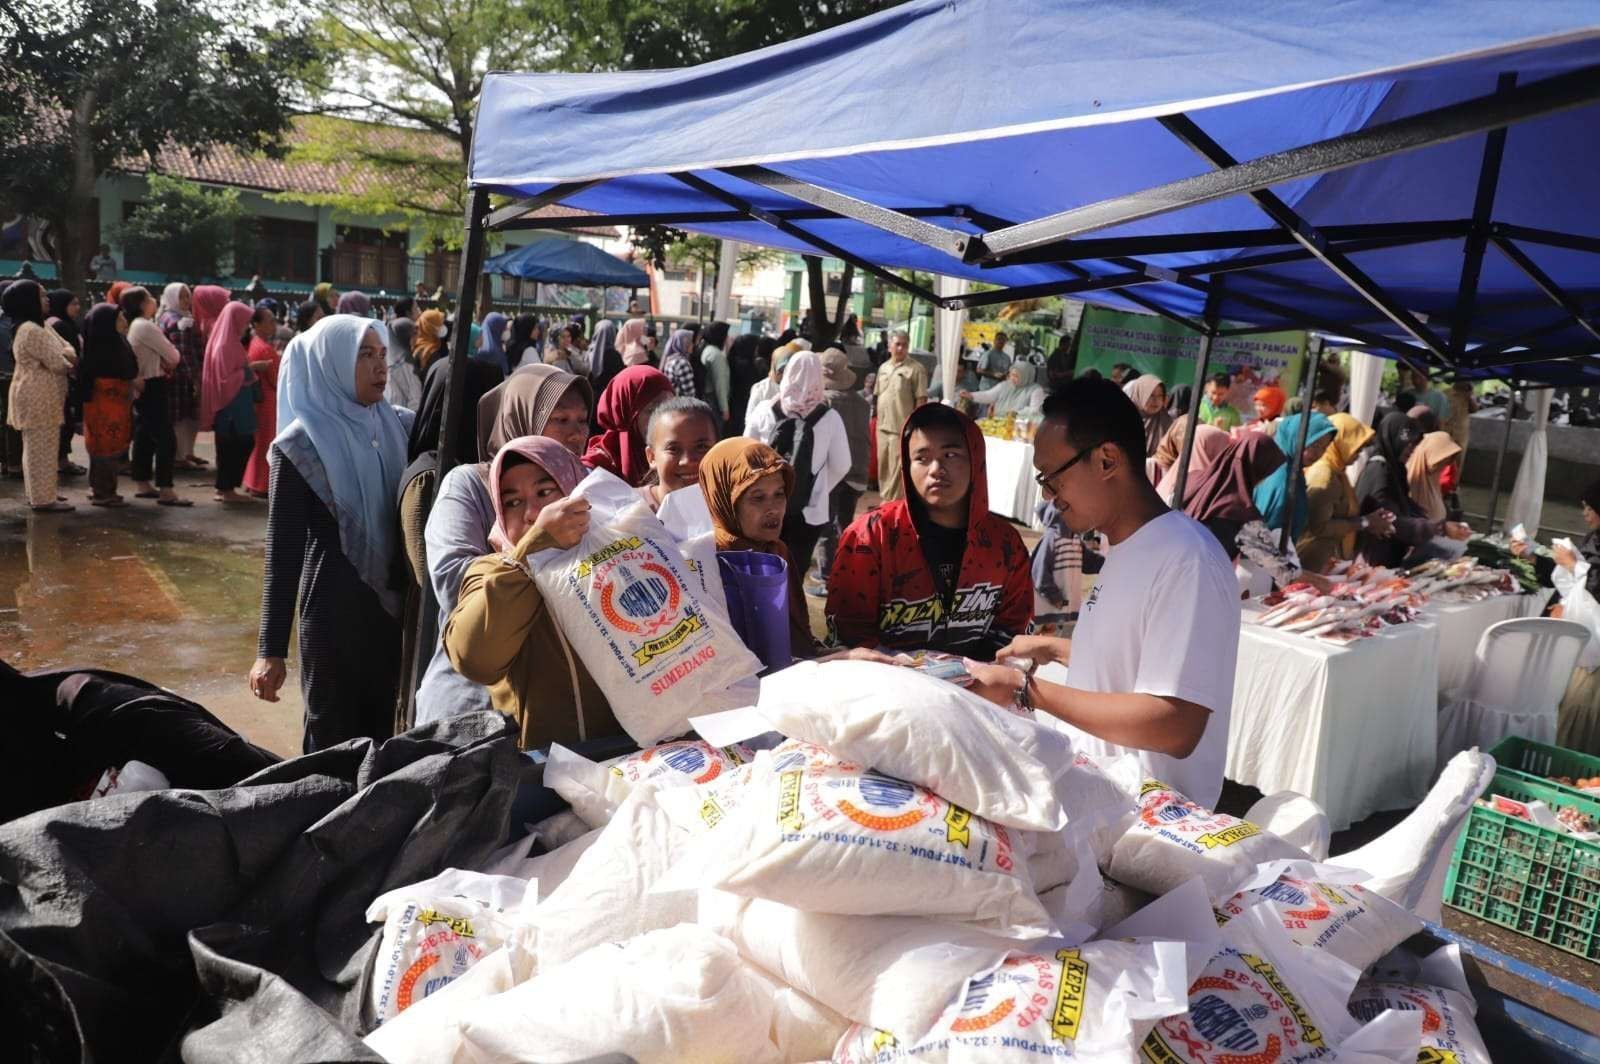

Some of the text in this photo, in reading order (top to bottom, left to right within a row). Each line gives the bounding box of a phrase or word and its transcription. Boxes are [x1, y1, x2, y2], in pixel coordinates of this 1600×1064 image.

[1232, 341, 1261, 351] HARGA
[1262, 343, 1298, 355] PANGAN
[650, 645, 716, 696] SUMEDANG
[1056, 961, 1085, 1028] KEPALA
[1223, 968, 1284, 1012] BERAS
